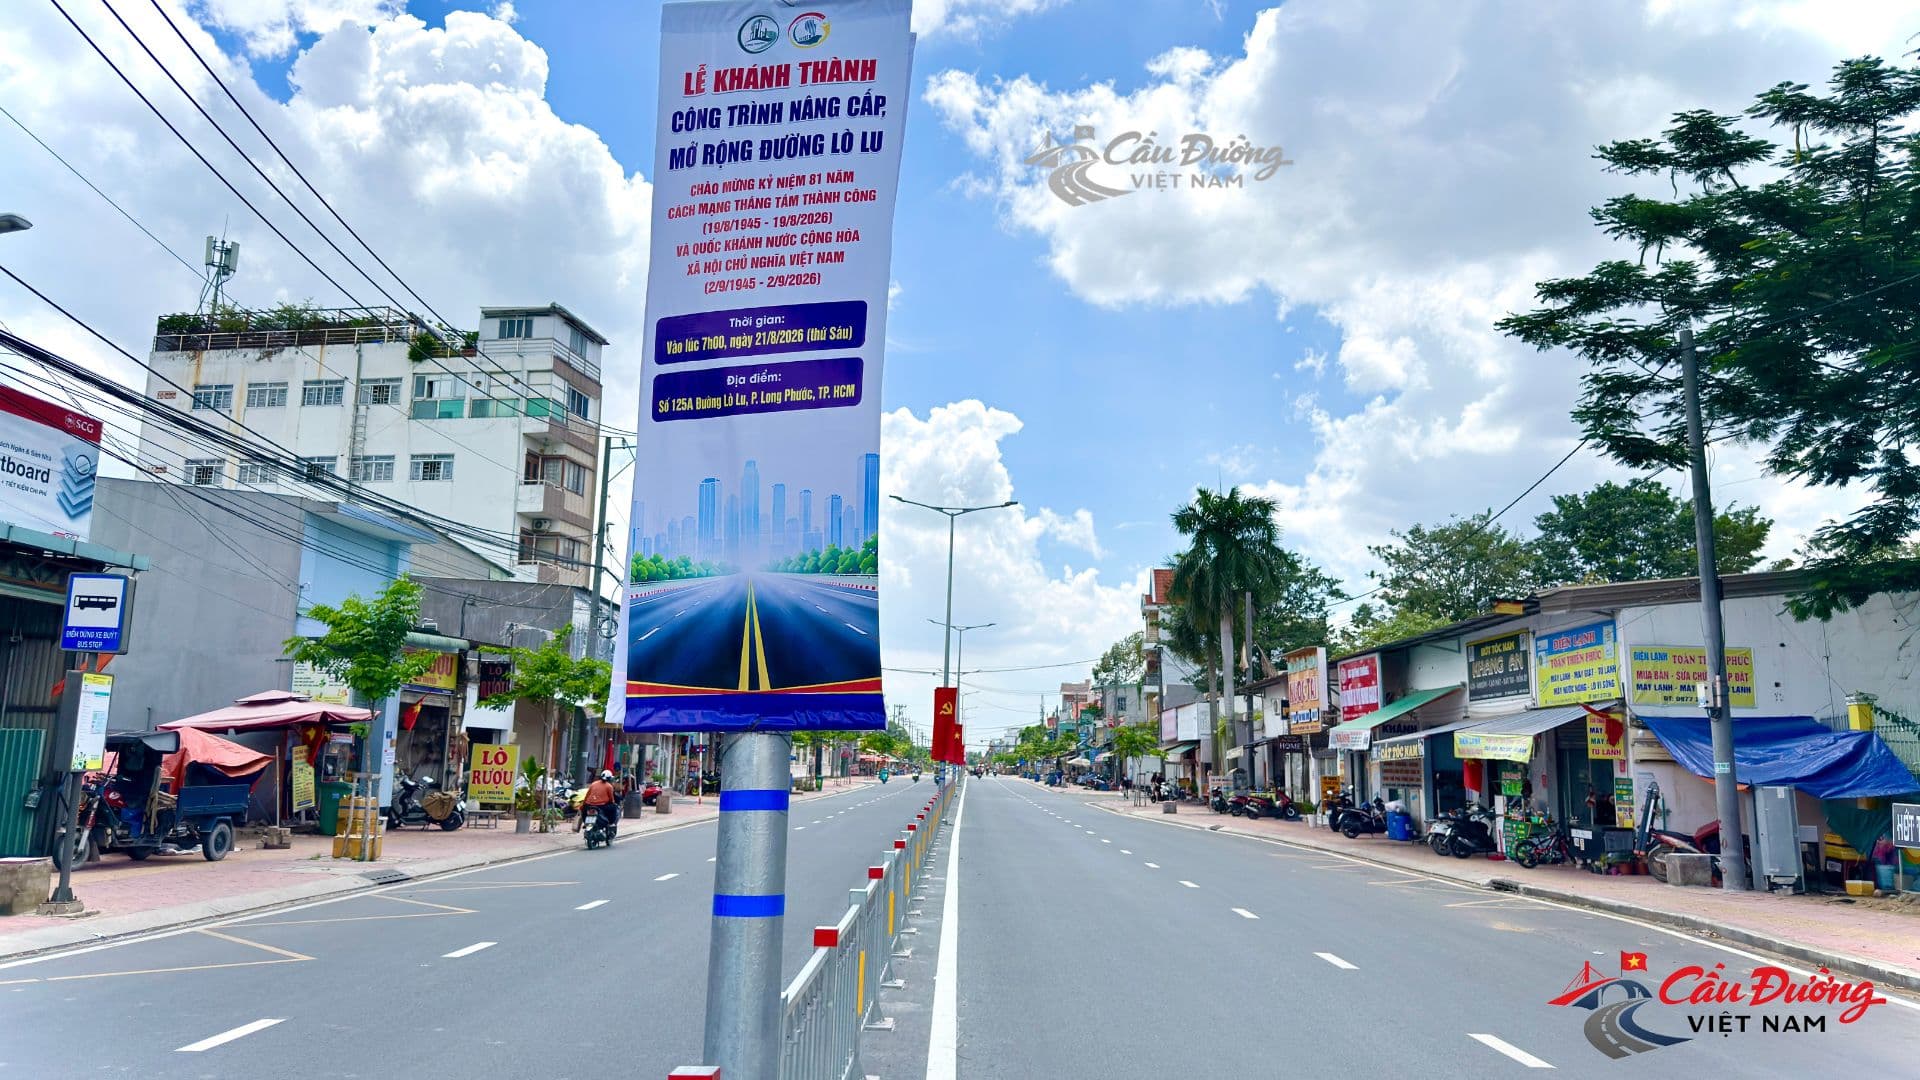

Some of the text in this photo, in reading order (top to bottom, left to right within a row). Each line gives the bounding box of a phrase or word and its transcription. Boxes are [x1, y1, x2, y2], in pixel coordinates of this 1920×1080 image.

[683, 57, 877, 97] LỄ KHÁNH THÀNH
[672, 107, 721, 133] CÔNG
[727, 100, 783, 127] TRÌNH
[790, 95, 840, 121] NÂNG
[669, 128, 884, 170] MỞ RỘNG ĐƯỜNG LÒ LU
[690, 170, 854, 197] CHÀO MỪNG KỶ NIỆM 81 NĂM
[668, 187, 877, 220] CÁCH MẠNG THÁNG TÁM THÀNH CÔNG
[702, 217, 761, 235] (19/8/1945
[773, 211, 833, 228] 19/8/2026)
[676, 228, 860, 258] VÀ QUỐC KHÁNH NƯỚC CỘNG HÒA
[687, 250, 845, 276] XÃ HỘI CHỦ NGHĨA VIỆT NAM
[704, 277, 756, 295] (2/9/1945
[767, 272, 821, 288] 2/9/2026)
[729, 314, 785, 328] Thời gian:
[667, 325, 853, 355] Vào lúc 7h00, ngày 21/8/2026 (thứ Sáu)
[726, 369, 782, 387] Địa điểm:
[658, 398, 670, 413] Số
[671, 396, 694, 412] 125A
[723, 392, 734, 408] Lò
[735, 392, 749, 408] Lu,
[751, 391, 760, 404] P.
[761, 390, 782, 406] Long
[785, 386, 816, 403] Phước,
[818, 385, 831, 399] TP.
[833, 384, 856, 398] HCM
[76, 419, 94, 433] SCG
[77, 640, 103, 649] BUS STOP
[481, 747, 508, 765] LÒ
[472, 768, 513, 789] RƯỢU
